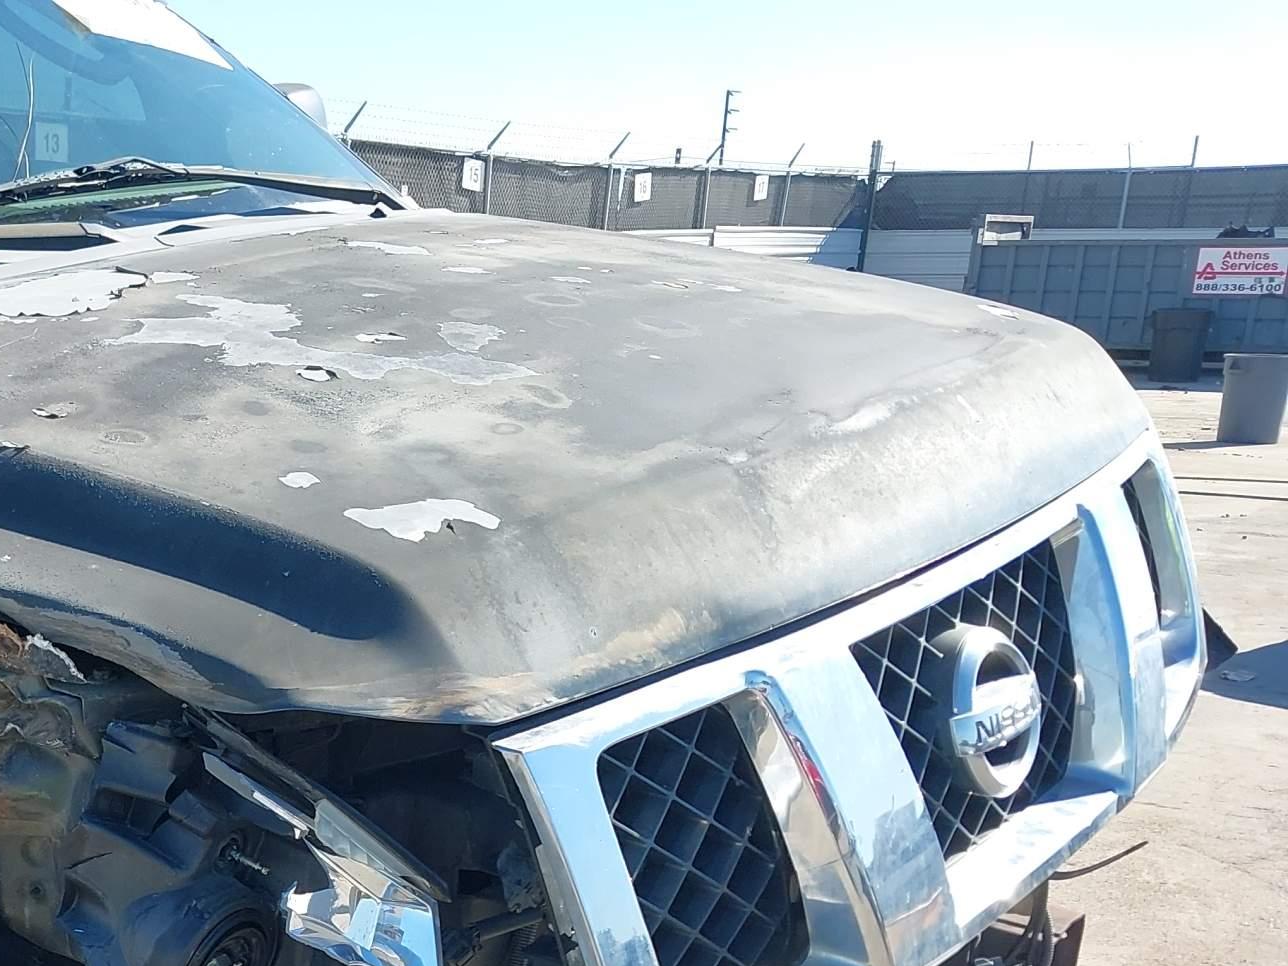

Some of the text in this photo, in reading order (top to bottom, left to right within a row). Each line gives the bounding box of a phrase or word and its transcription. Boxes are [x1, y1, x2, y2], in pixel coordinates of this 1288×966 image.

[43, 132, 60, 153] 13
[469, 166, 480, 184] 15
[1222, 251, 1271, 260] Athens
[1220, 260, 1279, 271] Services
[1195, 283, 1282, 292] 888/336-6100
